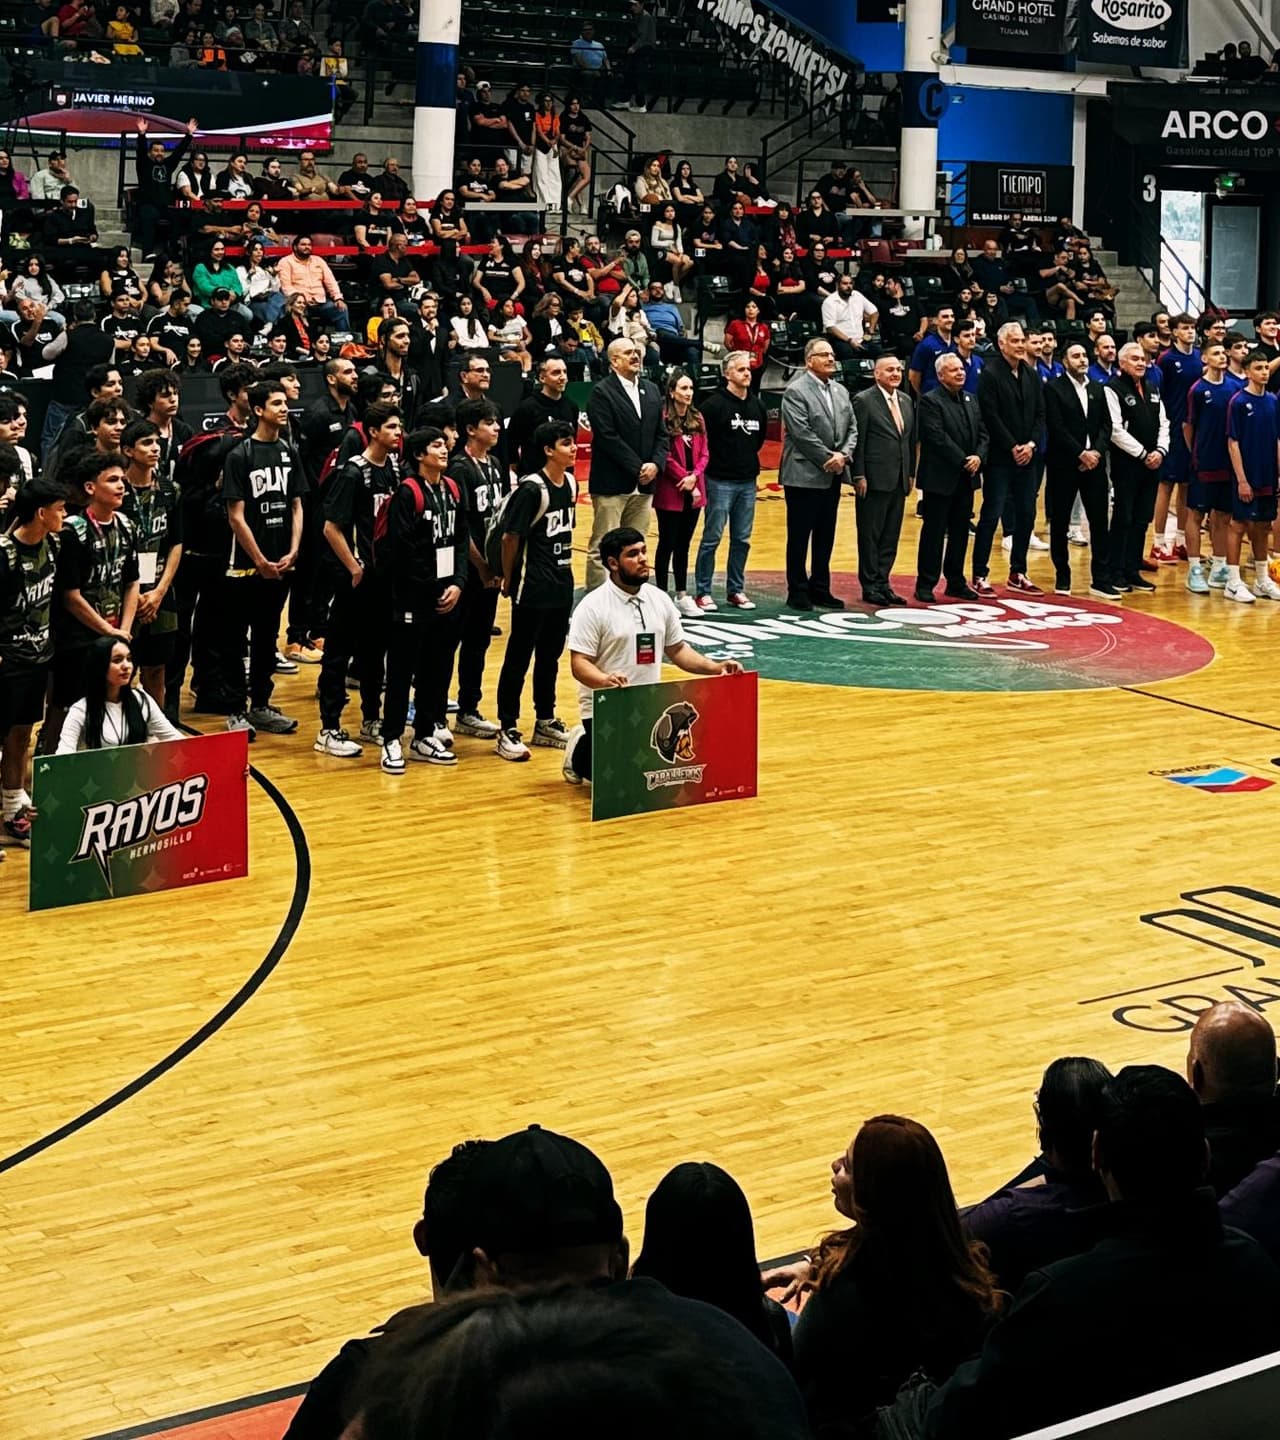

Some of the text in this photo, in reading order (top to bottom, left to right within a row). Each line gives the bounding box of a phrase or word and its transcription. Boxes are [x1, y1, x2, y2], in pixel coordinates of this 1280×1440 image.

[1018, 1, 1056, 17] HOTEL
[1130, 35, 1140, 46] de
[1141, 35, 1167, 49] sabor
[73, 92, 155, 106] JAVIER MERINO
[925, 83, 943, 117] C
[1161, 111, 1268, 141] ARCO
[1166, 145, 1210, 157] Gasolina
[1211, 146, 1250, 157] calidad
[1253, 147, 1276, 158] TOP
[1002, 174, 1042, 194] TIEMPO
[1142, 174, 1156, 203] 3
[77, 776, 206, 860] RAYOS
[130, 831, 192, 860] HERMOSILLO
